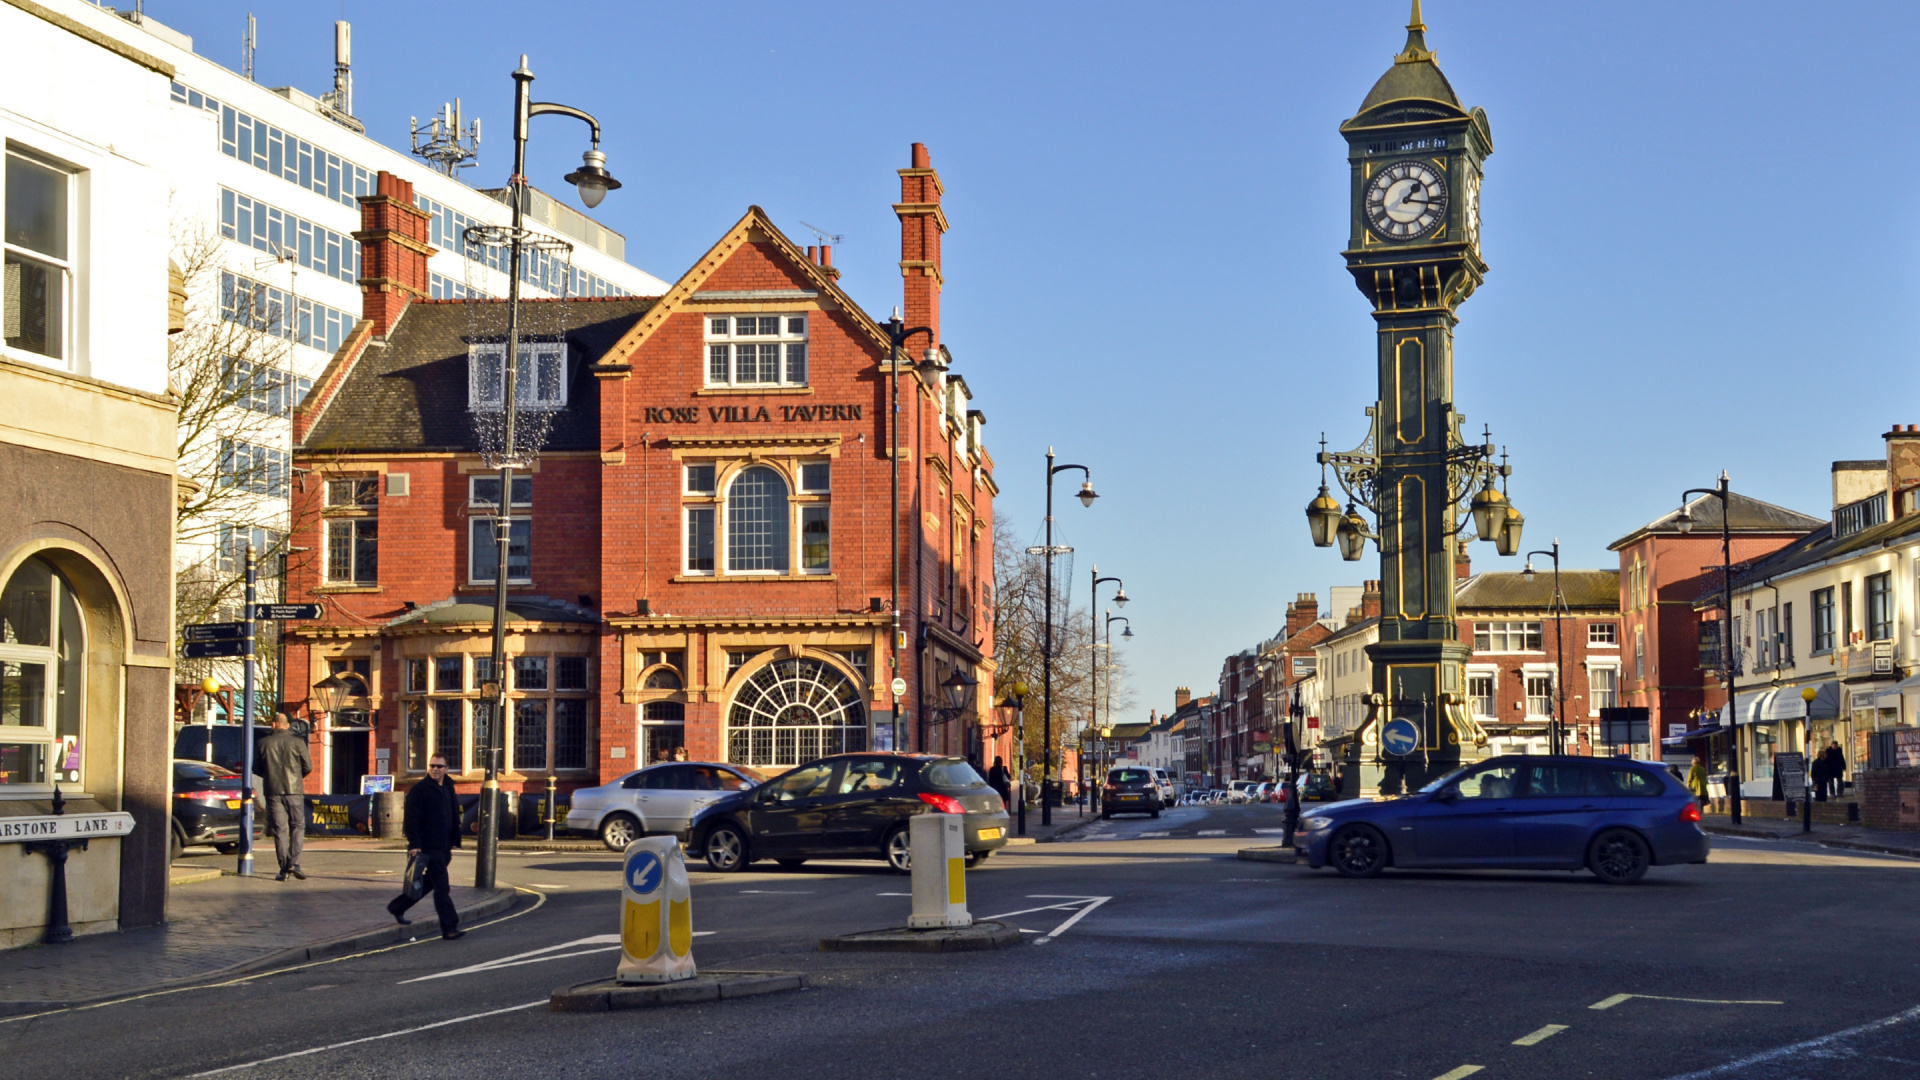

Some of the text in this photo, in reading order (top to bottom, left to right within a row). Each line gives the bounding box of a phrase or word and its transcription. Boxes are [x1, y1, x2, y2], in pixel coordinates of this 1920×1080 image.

[645, 404, 863, 423] ROSE VILLA TAVERN
[330, 804, 349, 813] VILLA
[312, 812, 350, 824] TAVERN
[75, 819, 108, 832] LANE
[115, 821, 122, 830] 18
